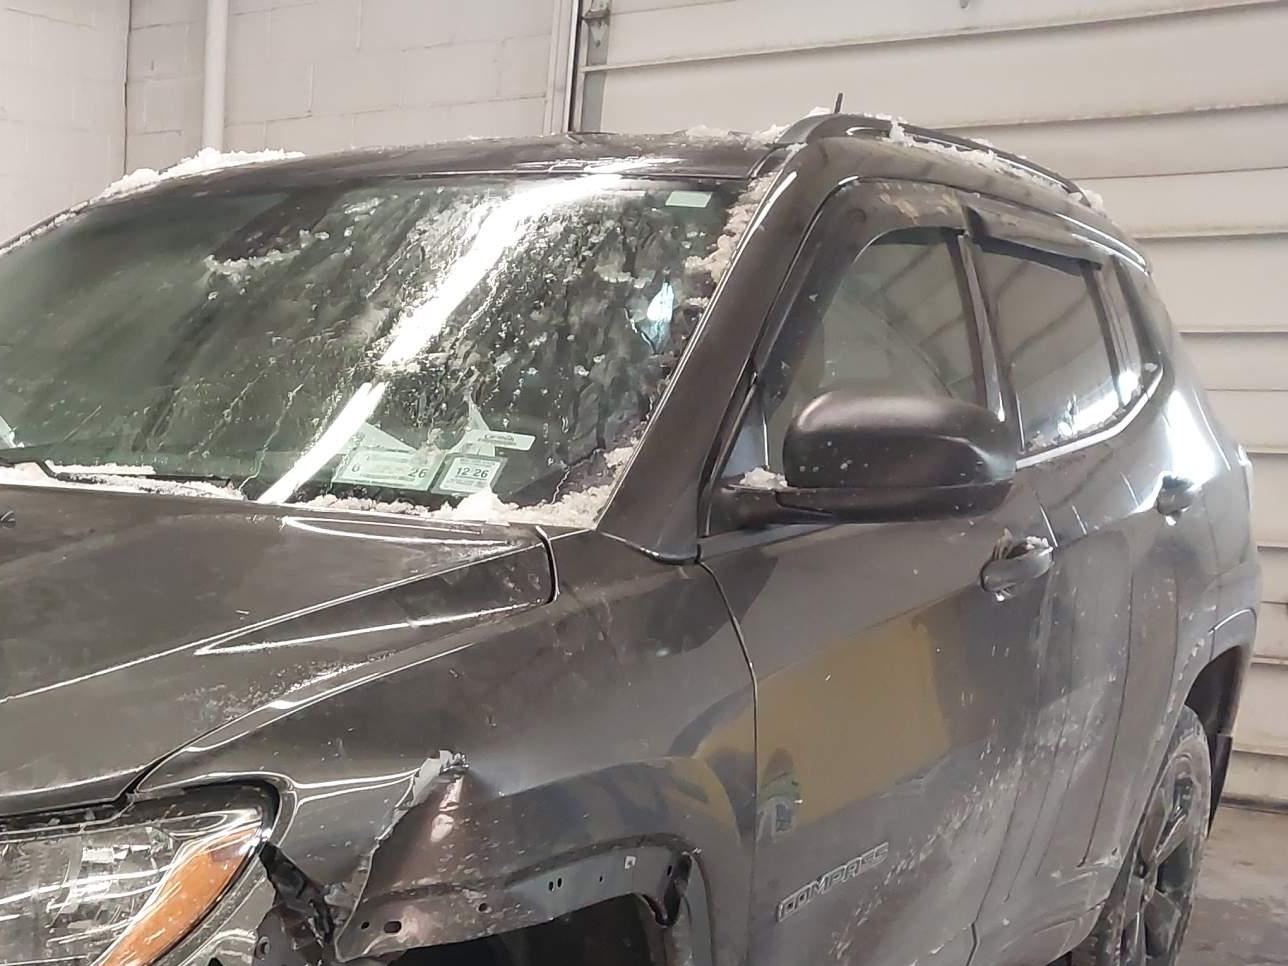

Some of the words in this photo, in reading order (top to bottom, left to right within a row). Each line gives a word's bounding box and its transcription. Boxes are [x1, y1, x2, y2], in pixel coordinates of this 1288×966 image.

[407, 468, 428, 479] 26
[456, 467, 470, 476] 12
[473, 469, 489, 478] 26
